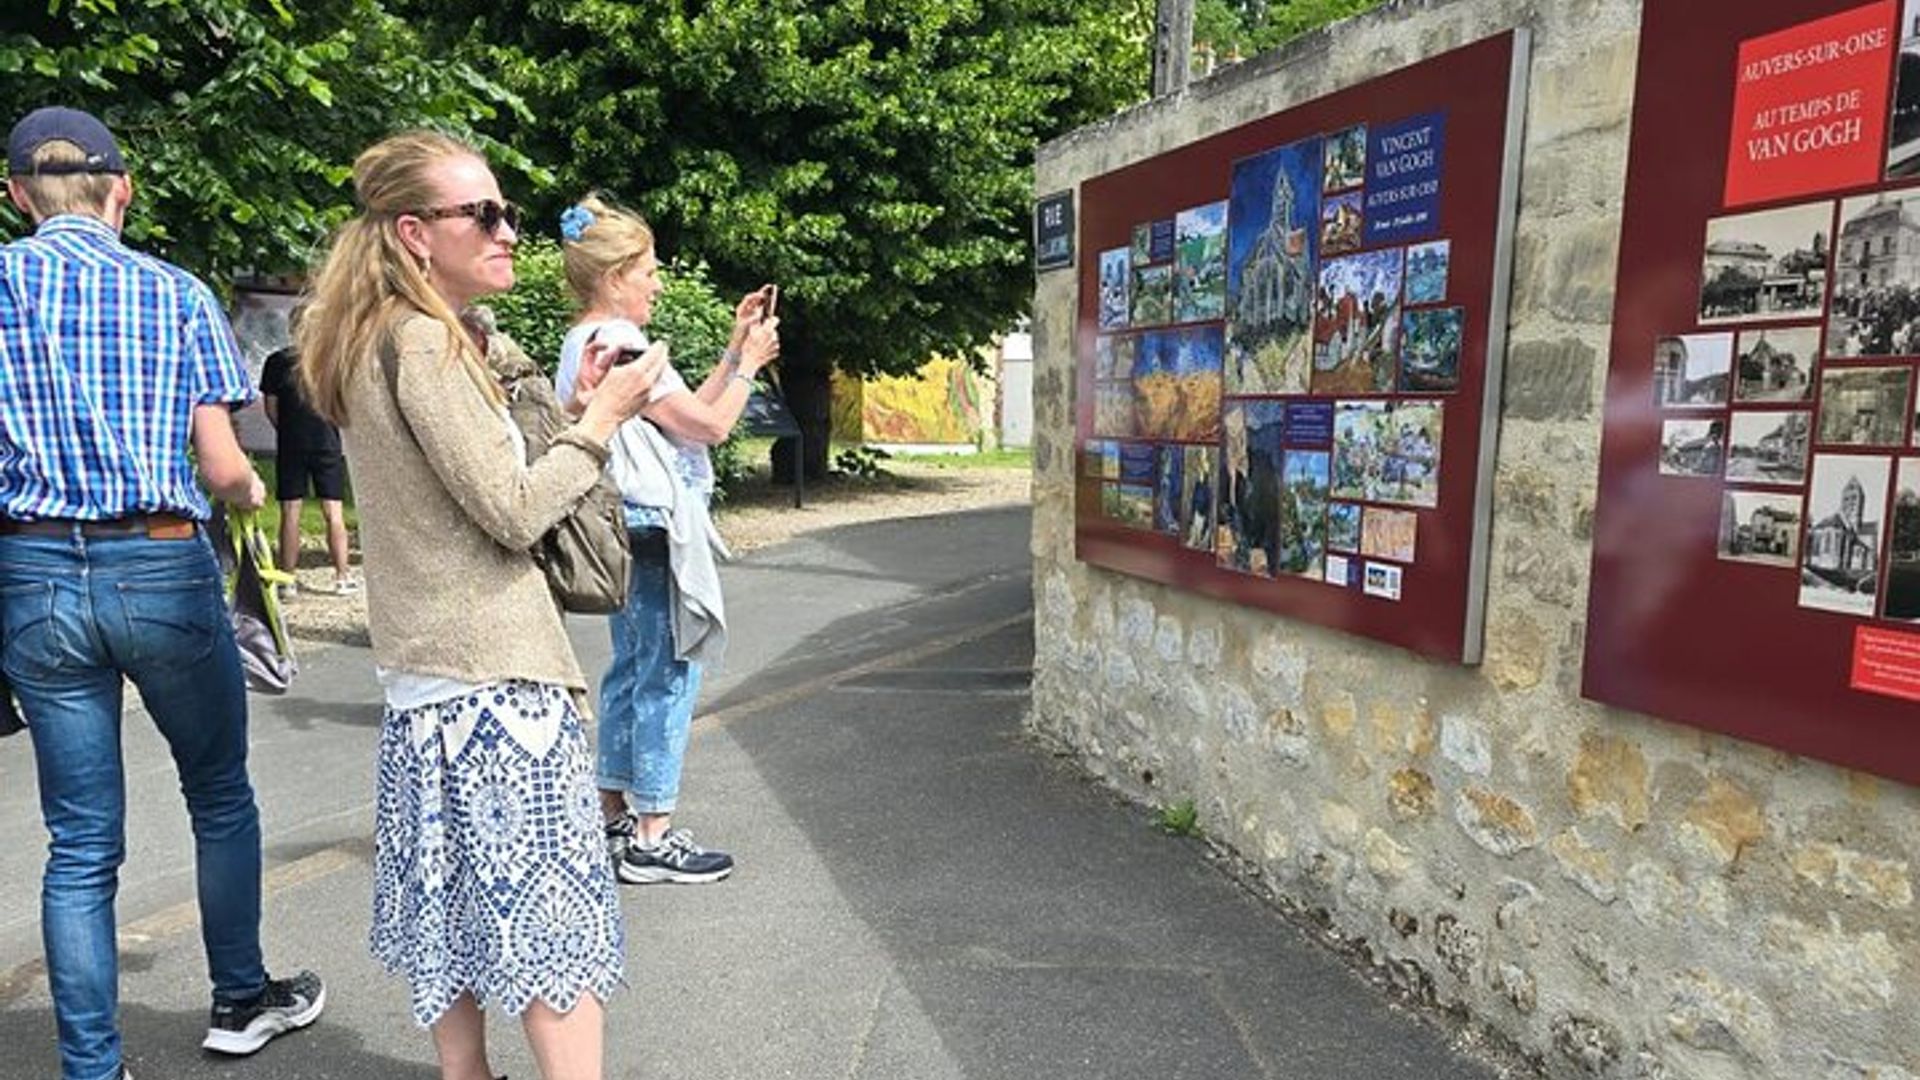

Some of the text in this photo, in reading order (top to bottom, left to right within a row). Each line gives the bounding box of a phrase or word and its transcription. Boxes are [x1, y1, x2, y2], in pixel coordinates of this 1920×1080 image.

[1740, 27, 1888, 82] AUVERS-SUR-OISE
[1752, 89, 1862, 131] AU TEMPS DE
[1381, 126, 1431, 155] VINCENT
[1746, 117, 1862, 161] VAN GOGH
[1399, 148, 1435, 174] GOGH
